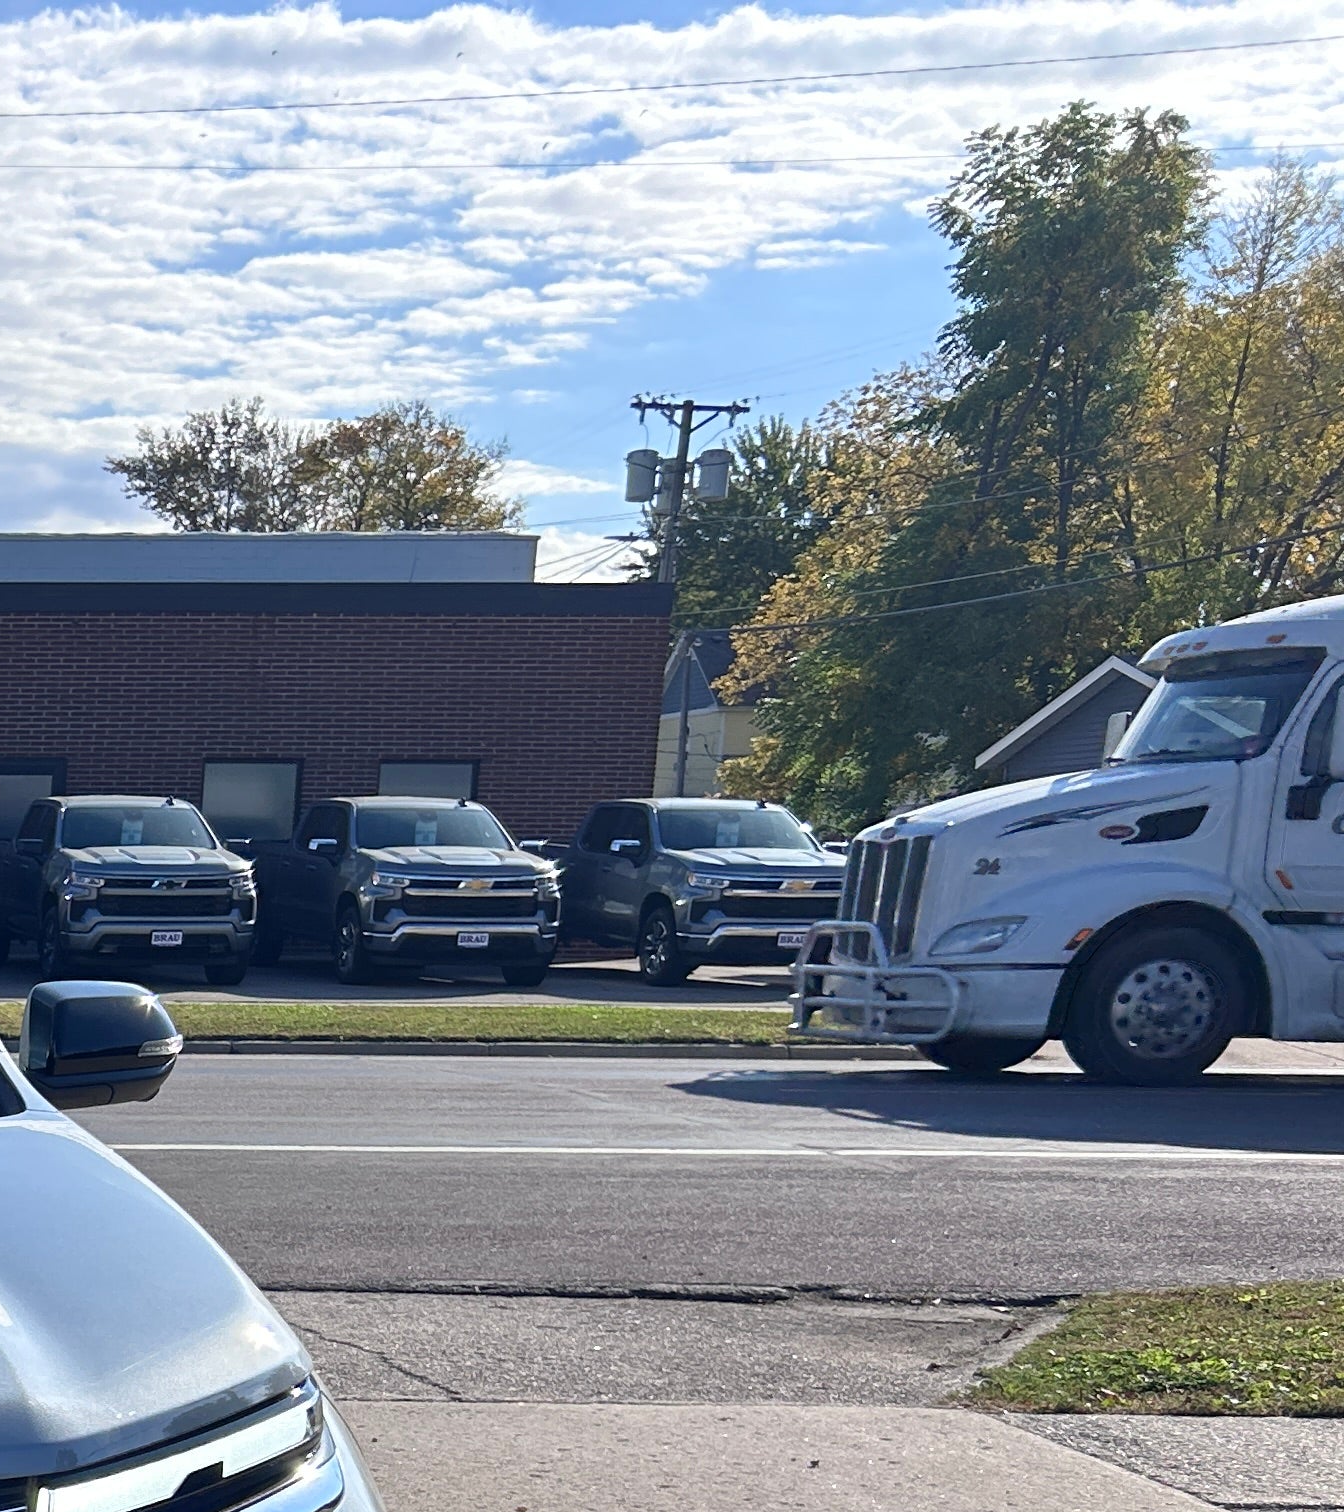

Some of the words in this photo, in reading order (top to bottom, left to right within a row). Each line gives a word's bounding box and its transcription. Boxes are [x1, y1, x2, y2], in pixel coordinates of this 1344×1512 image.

[973, 857, 1001, 875] 24
[153, 934, 181, 943] BRAU
[459, 935, 487, 944] BRAU
